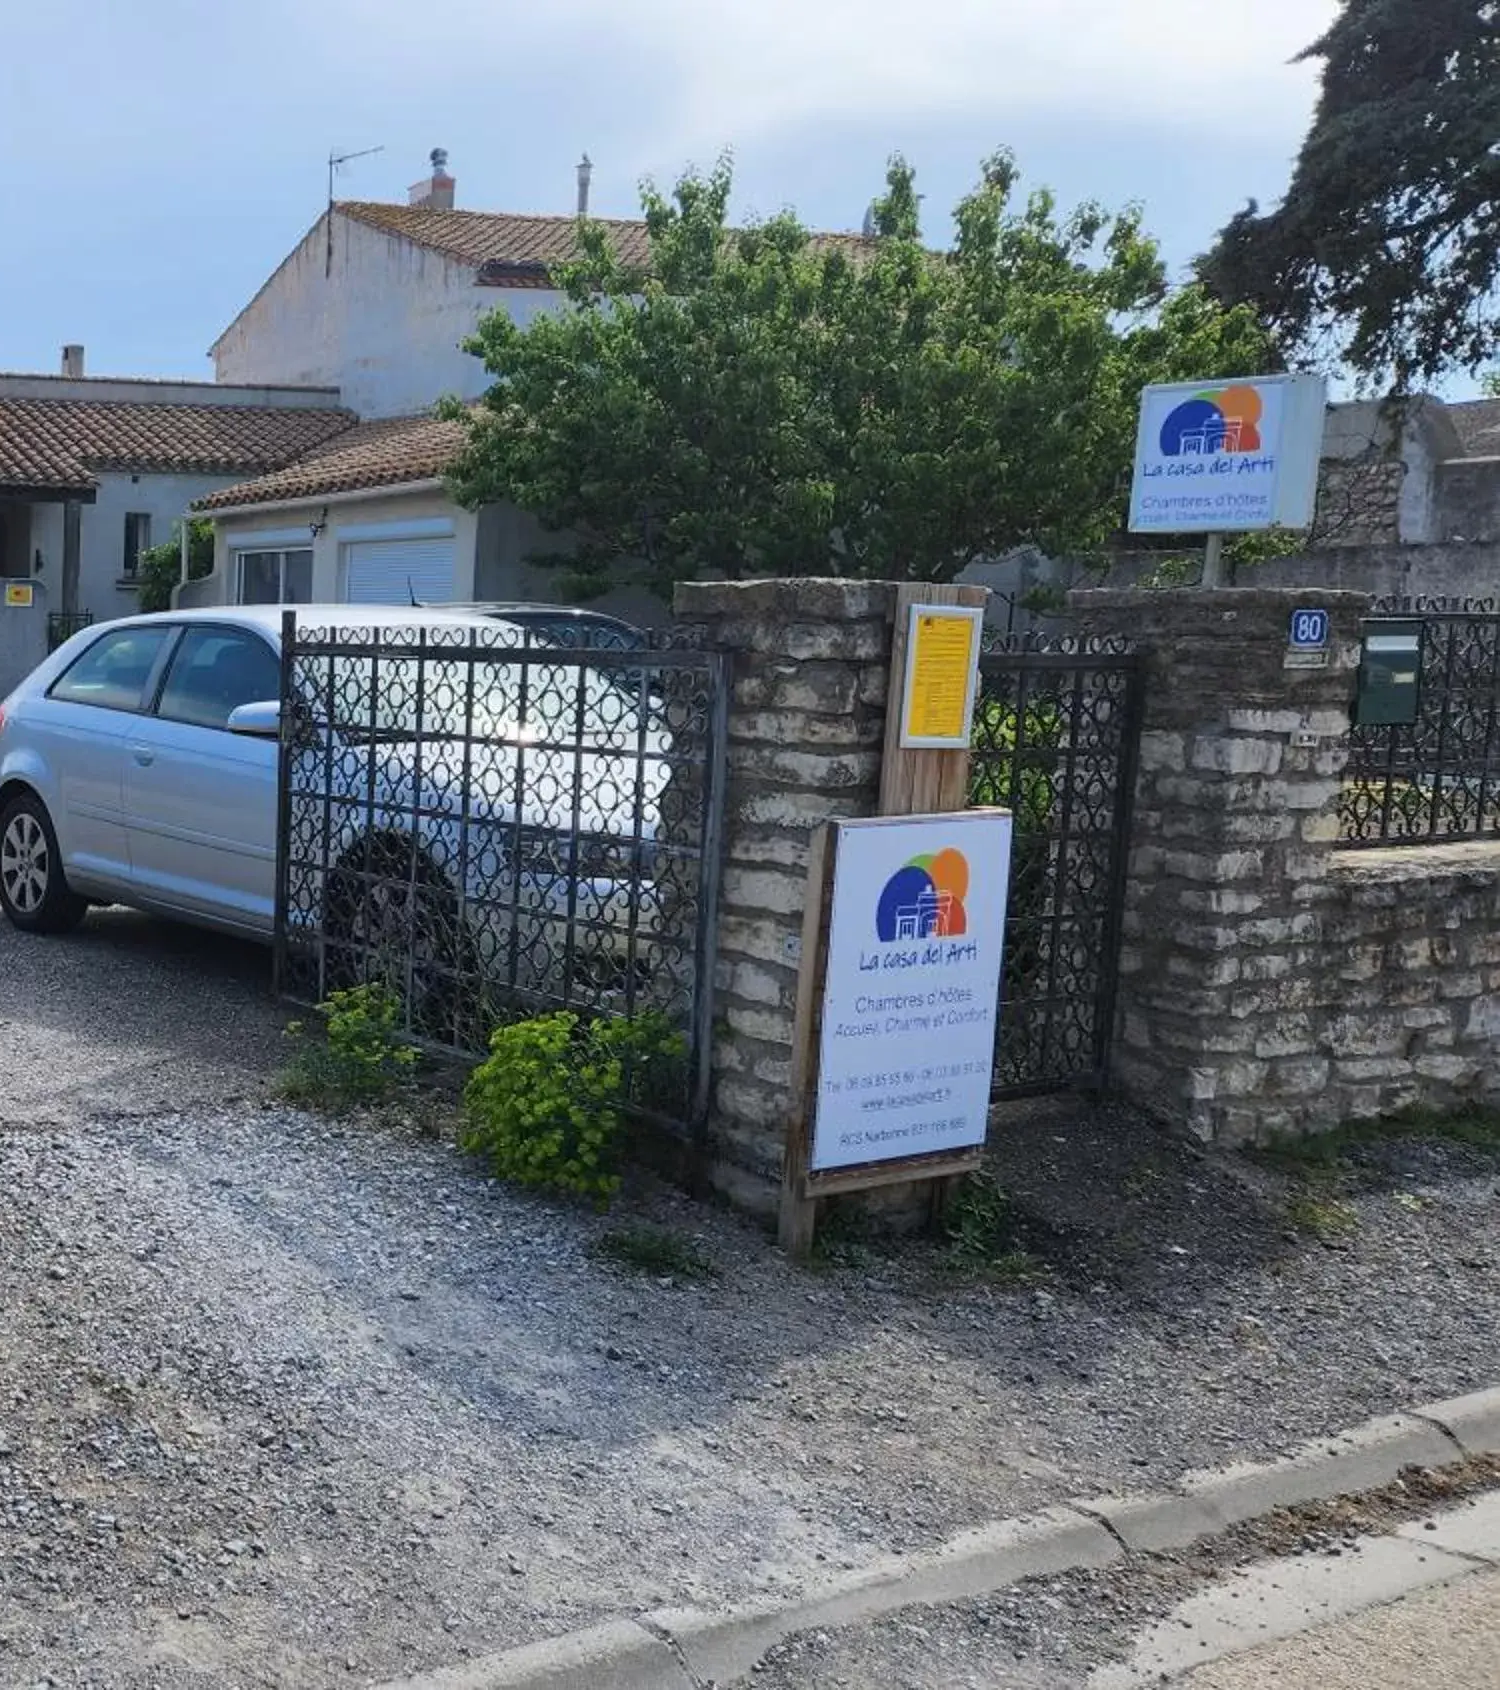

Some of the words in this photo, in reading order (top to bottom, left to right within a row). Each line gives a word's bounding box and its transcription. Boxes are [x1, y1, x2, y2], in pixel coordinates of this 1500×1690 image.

[1143, 462, 1163, 477] La
[1167, 462, 1205, 477] casa
[1209, 458, 1233, 475] del
[1236, 456, 1275, 475] Arti
[1141, 495, 1213, 509] Chambres
[1297, 614, 1321, 641] 80
[859, 950, 879, 971] La
[883, 950, 917, 969] casa
[921, 942, 943, 965] del
[944, 938, 978, 966] Arti
[855, 993, 925, 1014] Chambres
[927, 986, 974, 1005] d'hôtes
[885, 1015, 930, 1033] Charme
[947, 1007, 988, 1025] Confort
